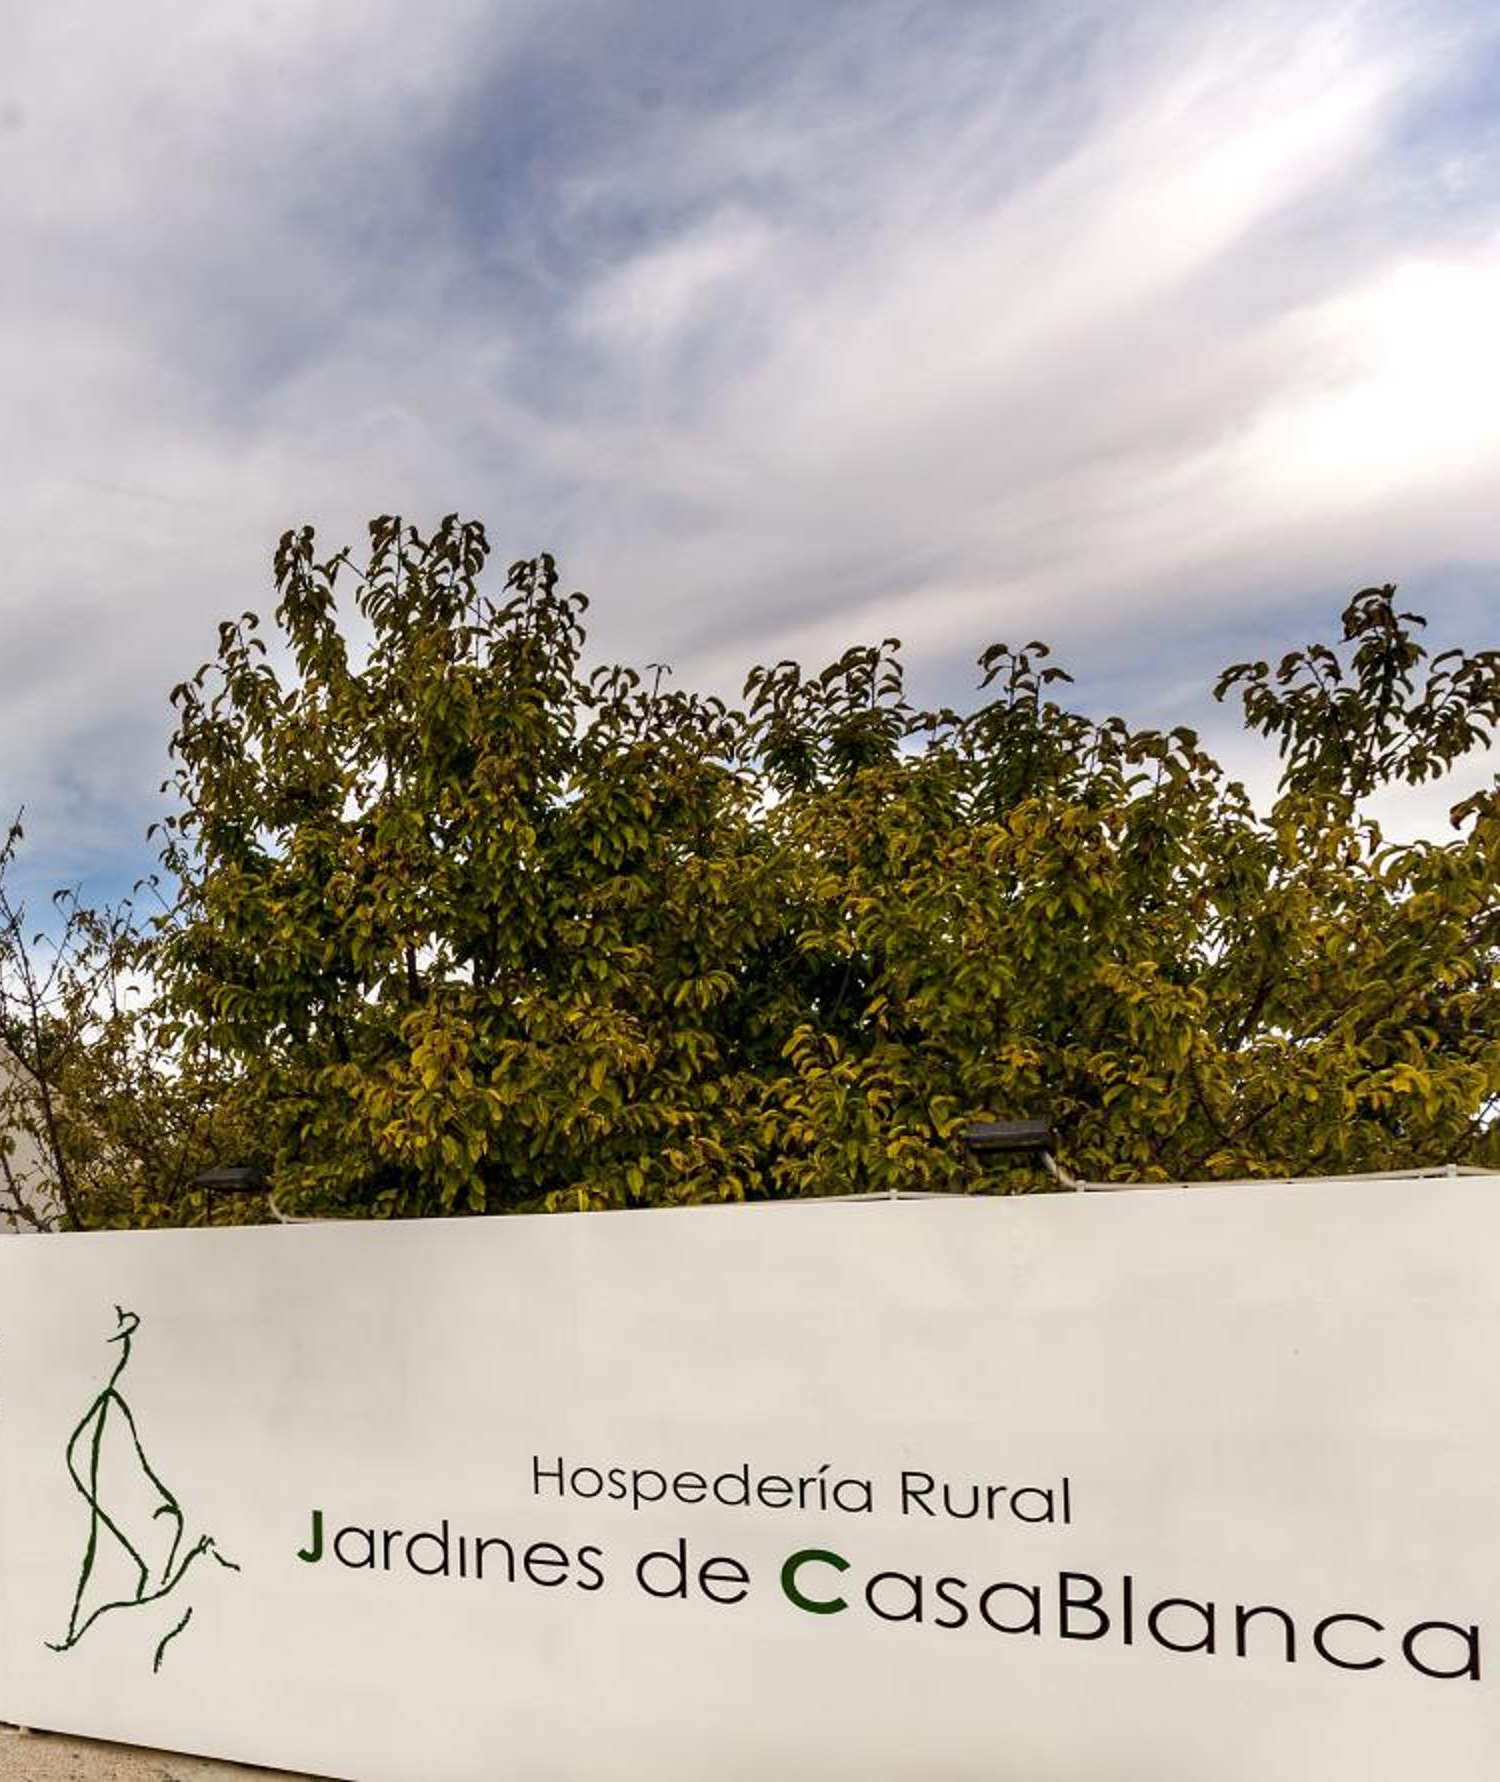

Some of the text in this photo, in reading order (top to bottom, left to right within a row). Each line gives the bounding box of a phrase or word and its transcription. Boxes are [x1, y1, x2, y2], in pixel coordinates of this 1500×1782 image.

[532, 1455, 1071, 1525] Hospedería Rural
[635, 1537, 751, 1605] de
[780, 1548, 1481, 1681] CasaBlanca
